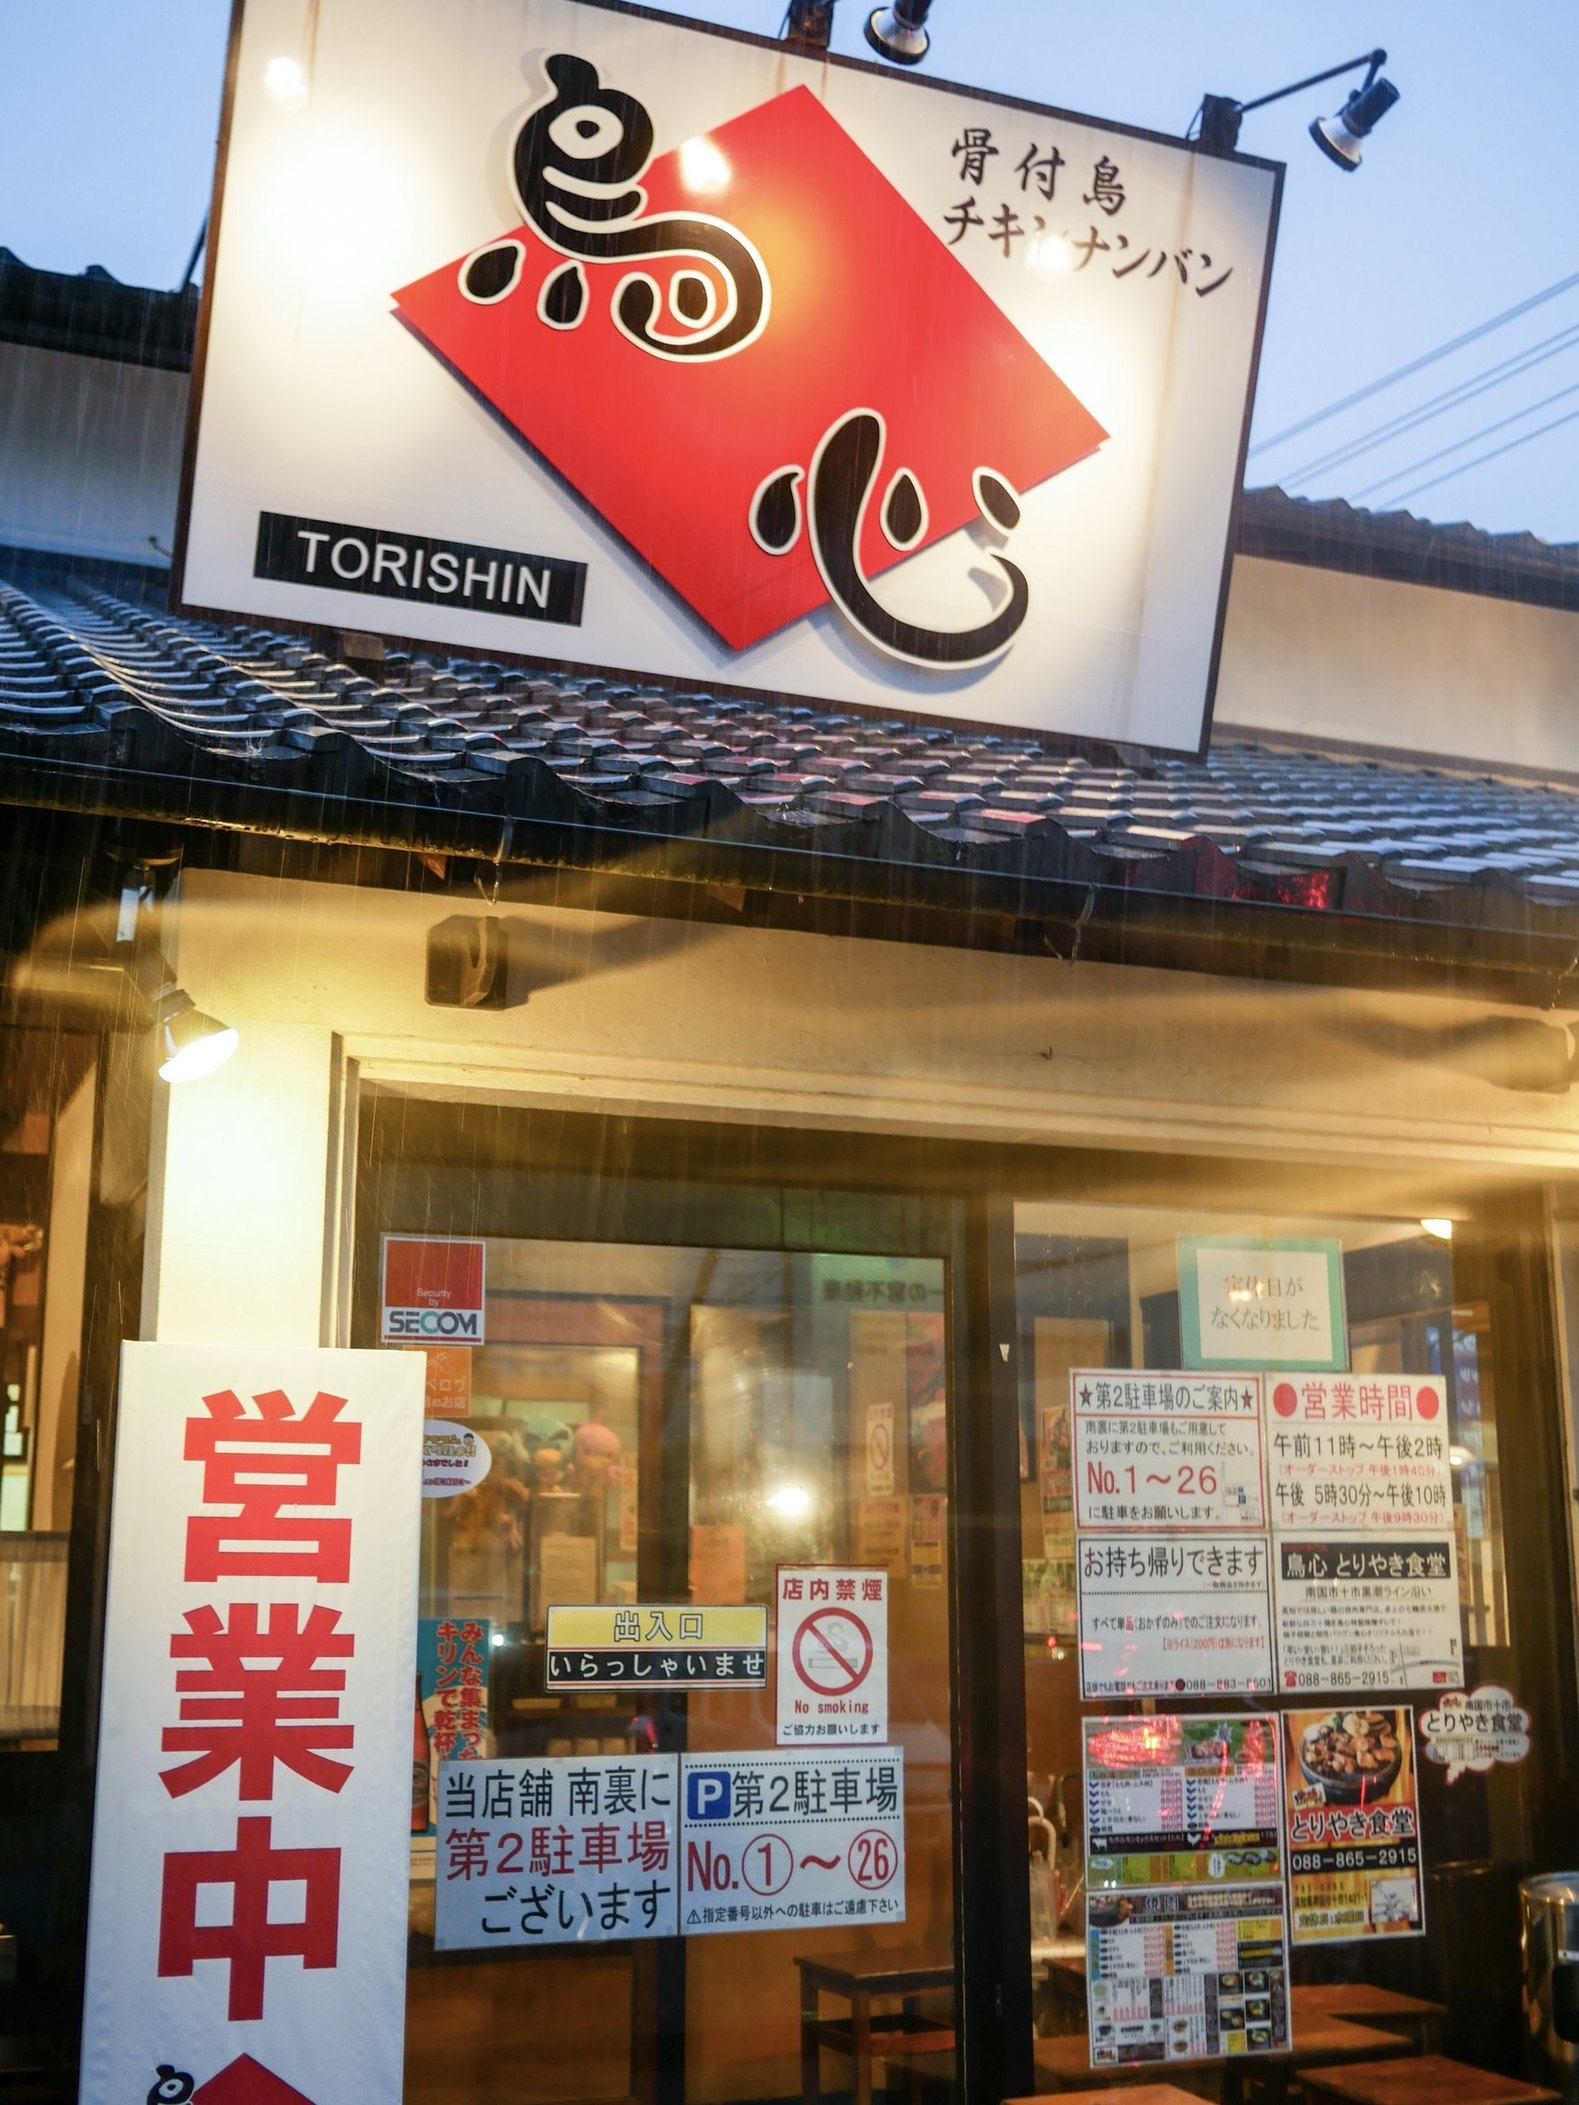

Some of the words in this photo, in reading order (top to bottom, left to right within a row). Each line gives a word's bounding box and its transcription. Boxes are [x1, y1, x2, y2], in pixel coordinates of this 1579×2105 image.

[952, 128, 1126, 216] 骨付鳥
[298, 528, 553, 612] TORISHIN
[417, 1288, 451, 1299] Security
[429, 1299, 438, 1307] by
[389, 1311, 477, 1335] SECOM
[1212, 1307, 1319, 1331] なくなりました
[1095, 1382, 1238, 1411] 第2駐車場のご案内
[1301, 1382, 1413, 1421] 営業時間
[1086, 1420, 1227, 1436] 南裏に第2駐車場もご用意して
[1086, 1440, 1255, 1457] おりますので、ご利用ください。
[1276, 1482, 1304, 1507] 午後
[1089, 1505, 1220, 1521] に駐車をお願いします。
[1084, 1545, 1263, 1578] お持ち帰りできます
[1336, 1552, 1446, 1578] とりやき食堂
[783, 1578, 882, 1601] 店内禁煙
[613, 1611, 704, 1643] 出入口
[550, 1653, 765, 1680] いらっしゃいませ
[1298, 1671, 1389, 1686] 088-865-2915
[434, 1621, 459, 1761] キリンで乾杯
[158, 1390, 362, 2022] 営業中
[794, 1700, 810, 1714] No
[818, 1701, 869, 1716] smoking
[783, 1723, 881, 1737] ご協力お願いします
[1427, 1712, 1522, 1732] とりやき食堂
[446, 1769, 553, 1820] 当店舗
[568, 1767, 672, 1817] 南裏に
[733, 1767, 899, 1820] 第2駐車場
[1291, 1807, 1415, 1843] とりやき食堂
[446, 1820, 672, 1881] 第2駐車場
[1292, 1848, 1417, 1871] 088-865-2915
[482, 1880, 672, 1935] ございます
[704, 1897, 899, 1925] 指定番号以外への駐車はご遠慮下さい
